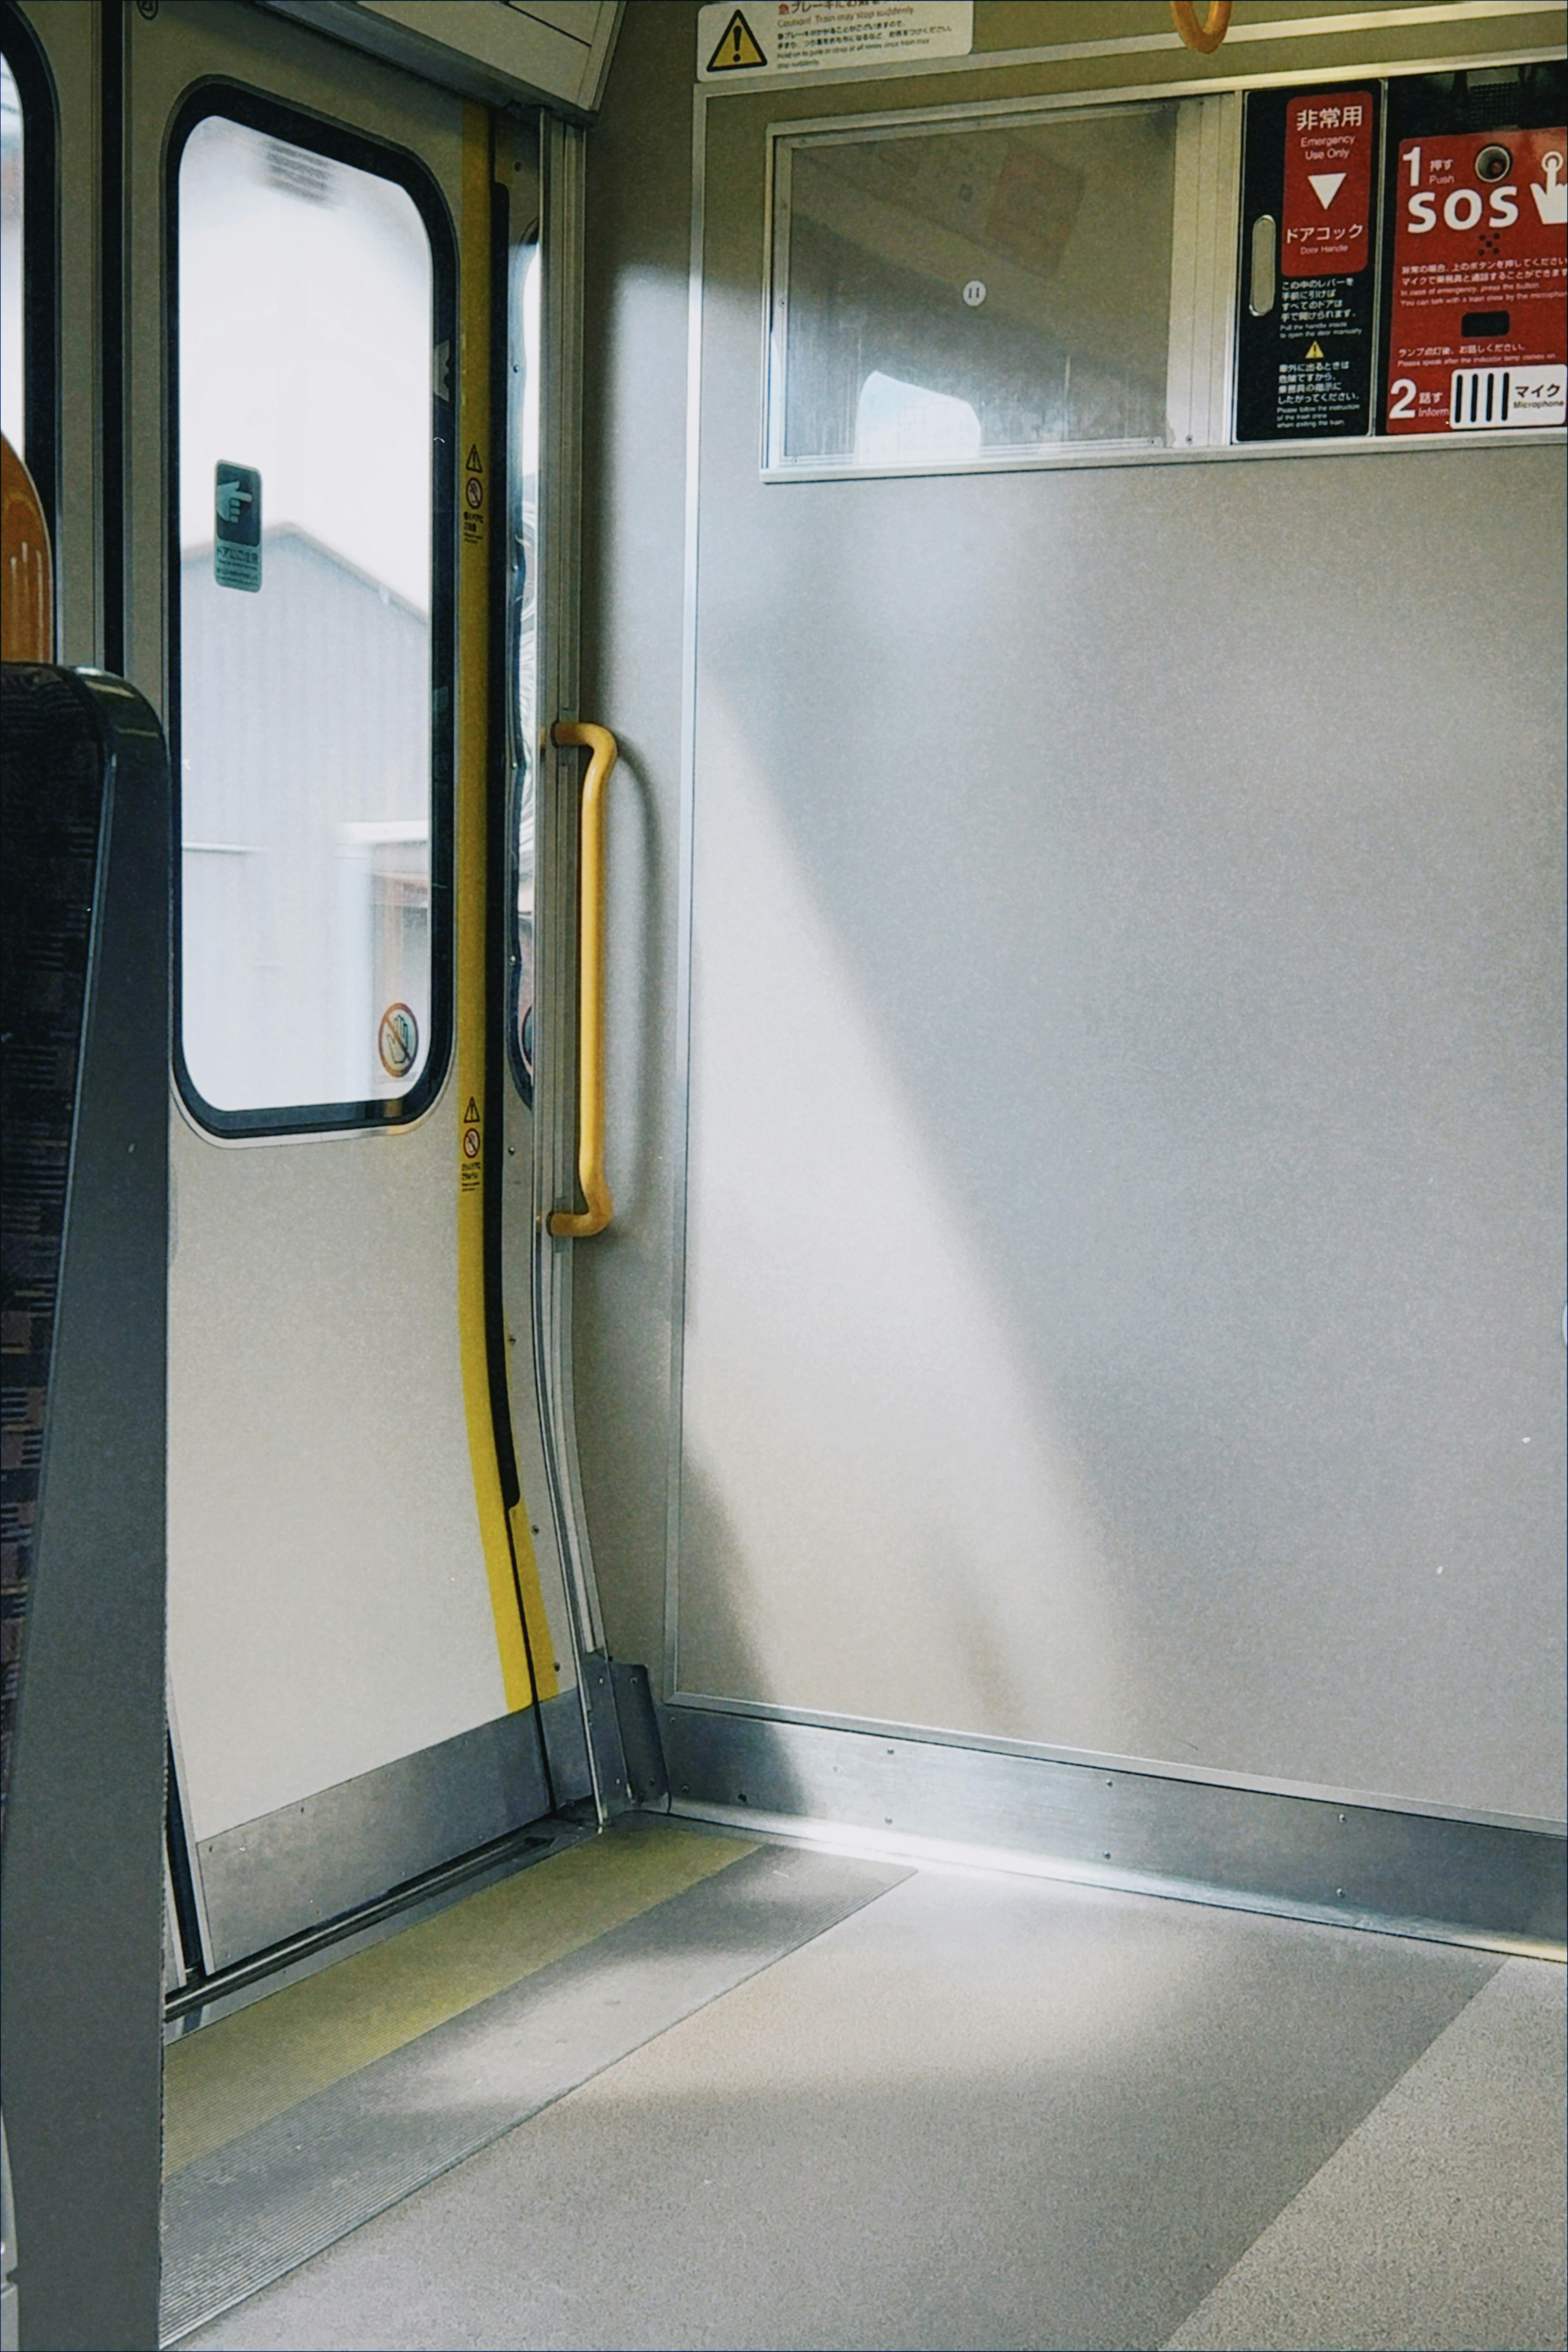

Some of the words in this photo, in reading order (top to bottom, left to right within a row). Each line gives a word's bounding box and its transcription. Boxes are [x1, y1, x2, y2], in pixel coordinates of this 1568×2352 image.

[1296, 105, 1362, 131] 非常用
[1301, 135, 1356, 147] Emergency
[1305, 150, 1325, 160] Use
[1327, 148, 1350, 159] Only
[1403, 146, 1421, 187] 1
[1430, 159, 1453, 172] 押す
[1429, 174, 1454, 184] Push
[1408, 185, 1519, 234] SOS
[1287, 223, 1363, 244] ドアコック
[1301, 246, 1319, 254] Door
[1321, 244, 1348, 252] Handle
[1282, 277, 1354, 290] この中のレバーを
[1282, 289, 1336, 301] 手前に引けば
[1282, 299, 1343, 311] すべてのドアは
[1281, 309, 1356, 323] 手で開けられます。
[1515, 383, 1561, 398] マイク
[1278, 392, 1359, 405] したがってください。
[1389, 378, 1417, 419] 2
[1419, 391, 1443, 405] 話す
[1514, 400, 1564, 409] Microphone
[1419, 407, 1449, 417] Inform
